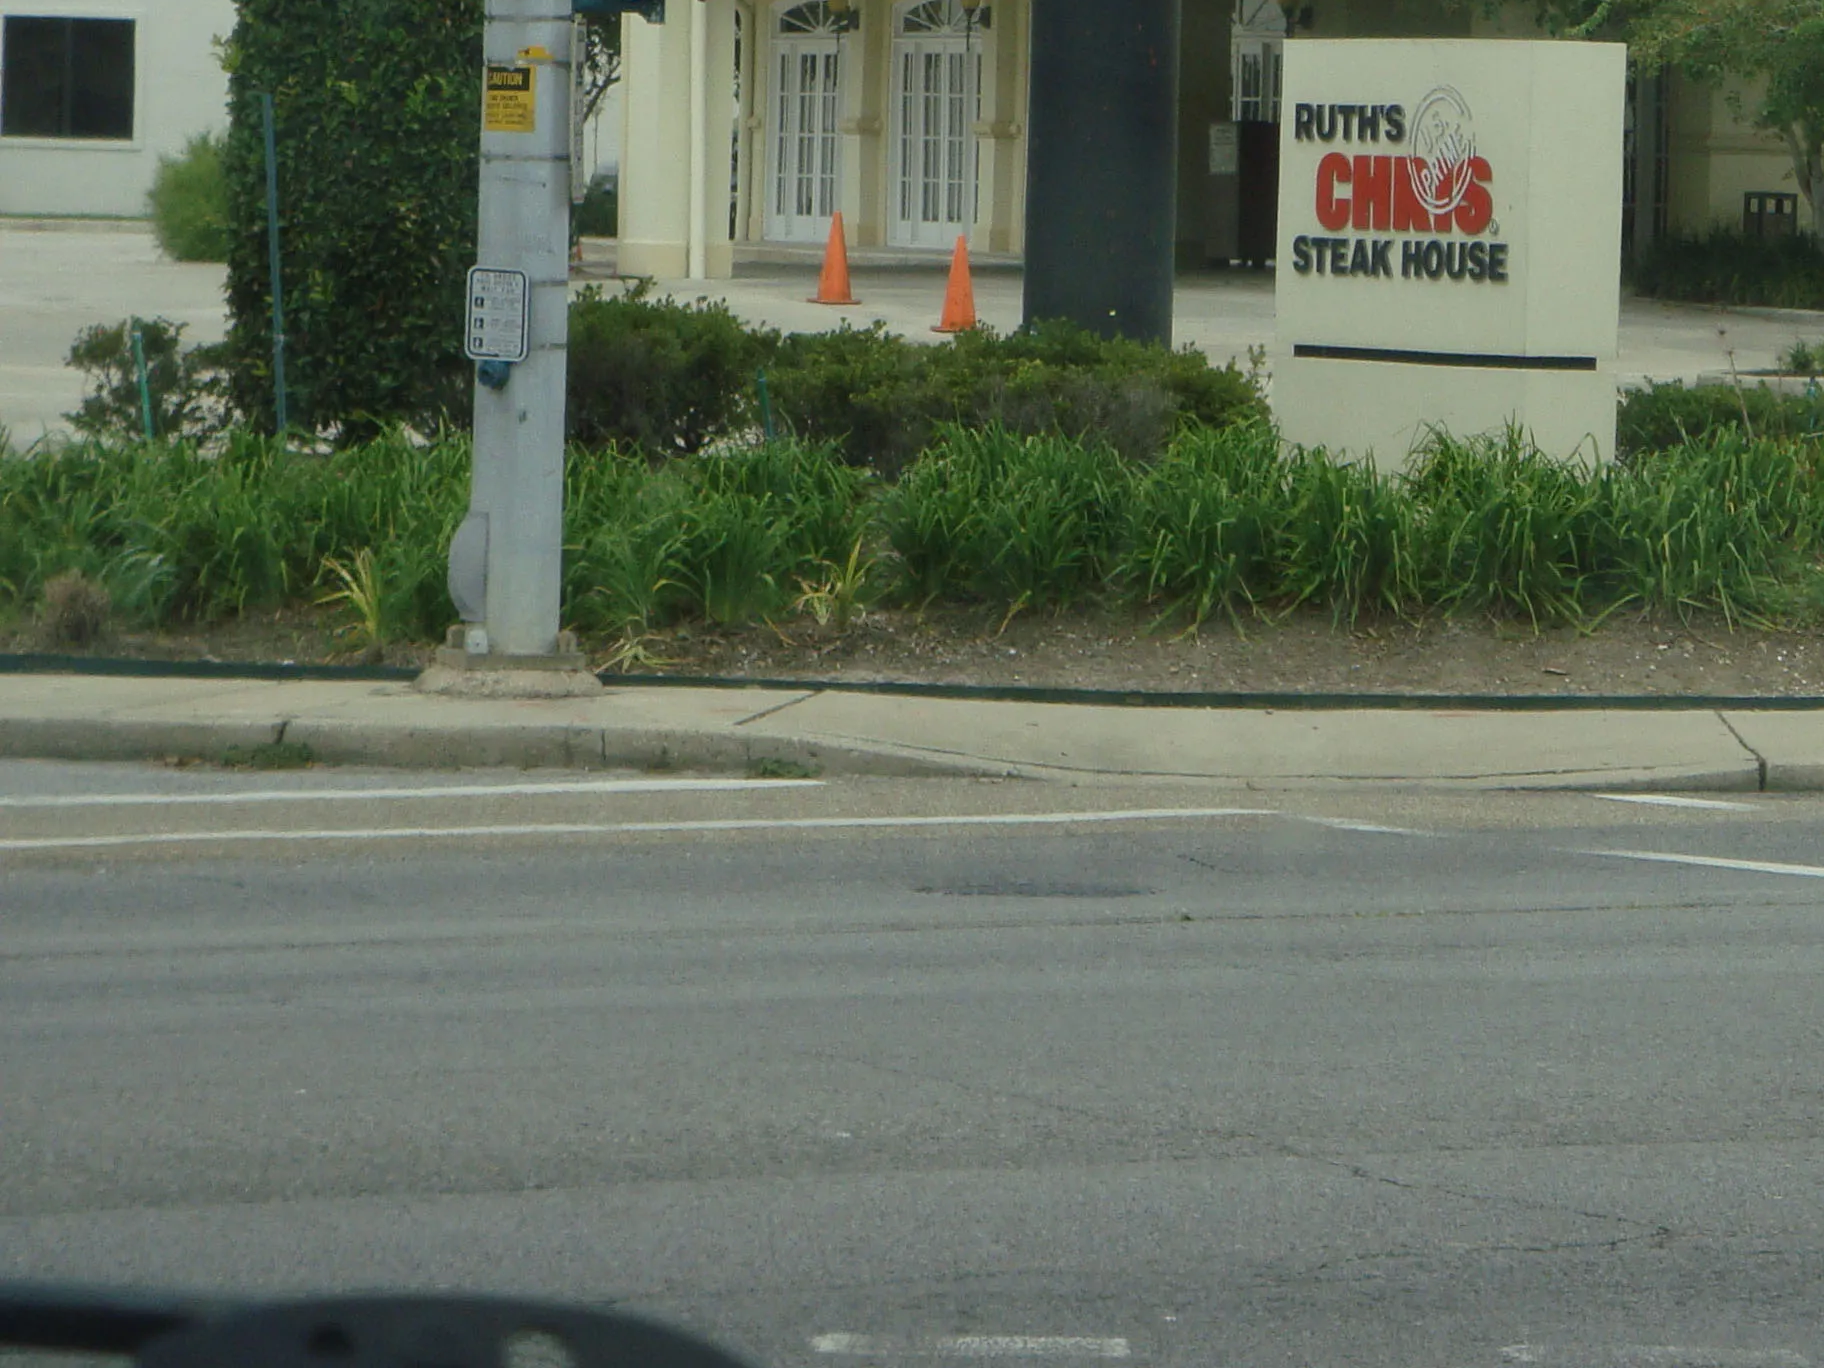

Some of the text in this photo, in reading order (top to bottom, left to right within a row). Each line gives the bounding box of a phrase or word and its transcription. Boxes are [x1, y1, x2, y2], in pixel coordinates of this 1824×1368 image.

[1294, 103, 1406, 143] RUTH'S
[1315, 152, 1493, 235] CHRIS
[1292, 235, 1509, 282] STEAK HOUSE
